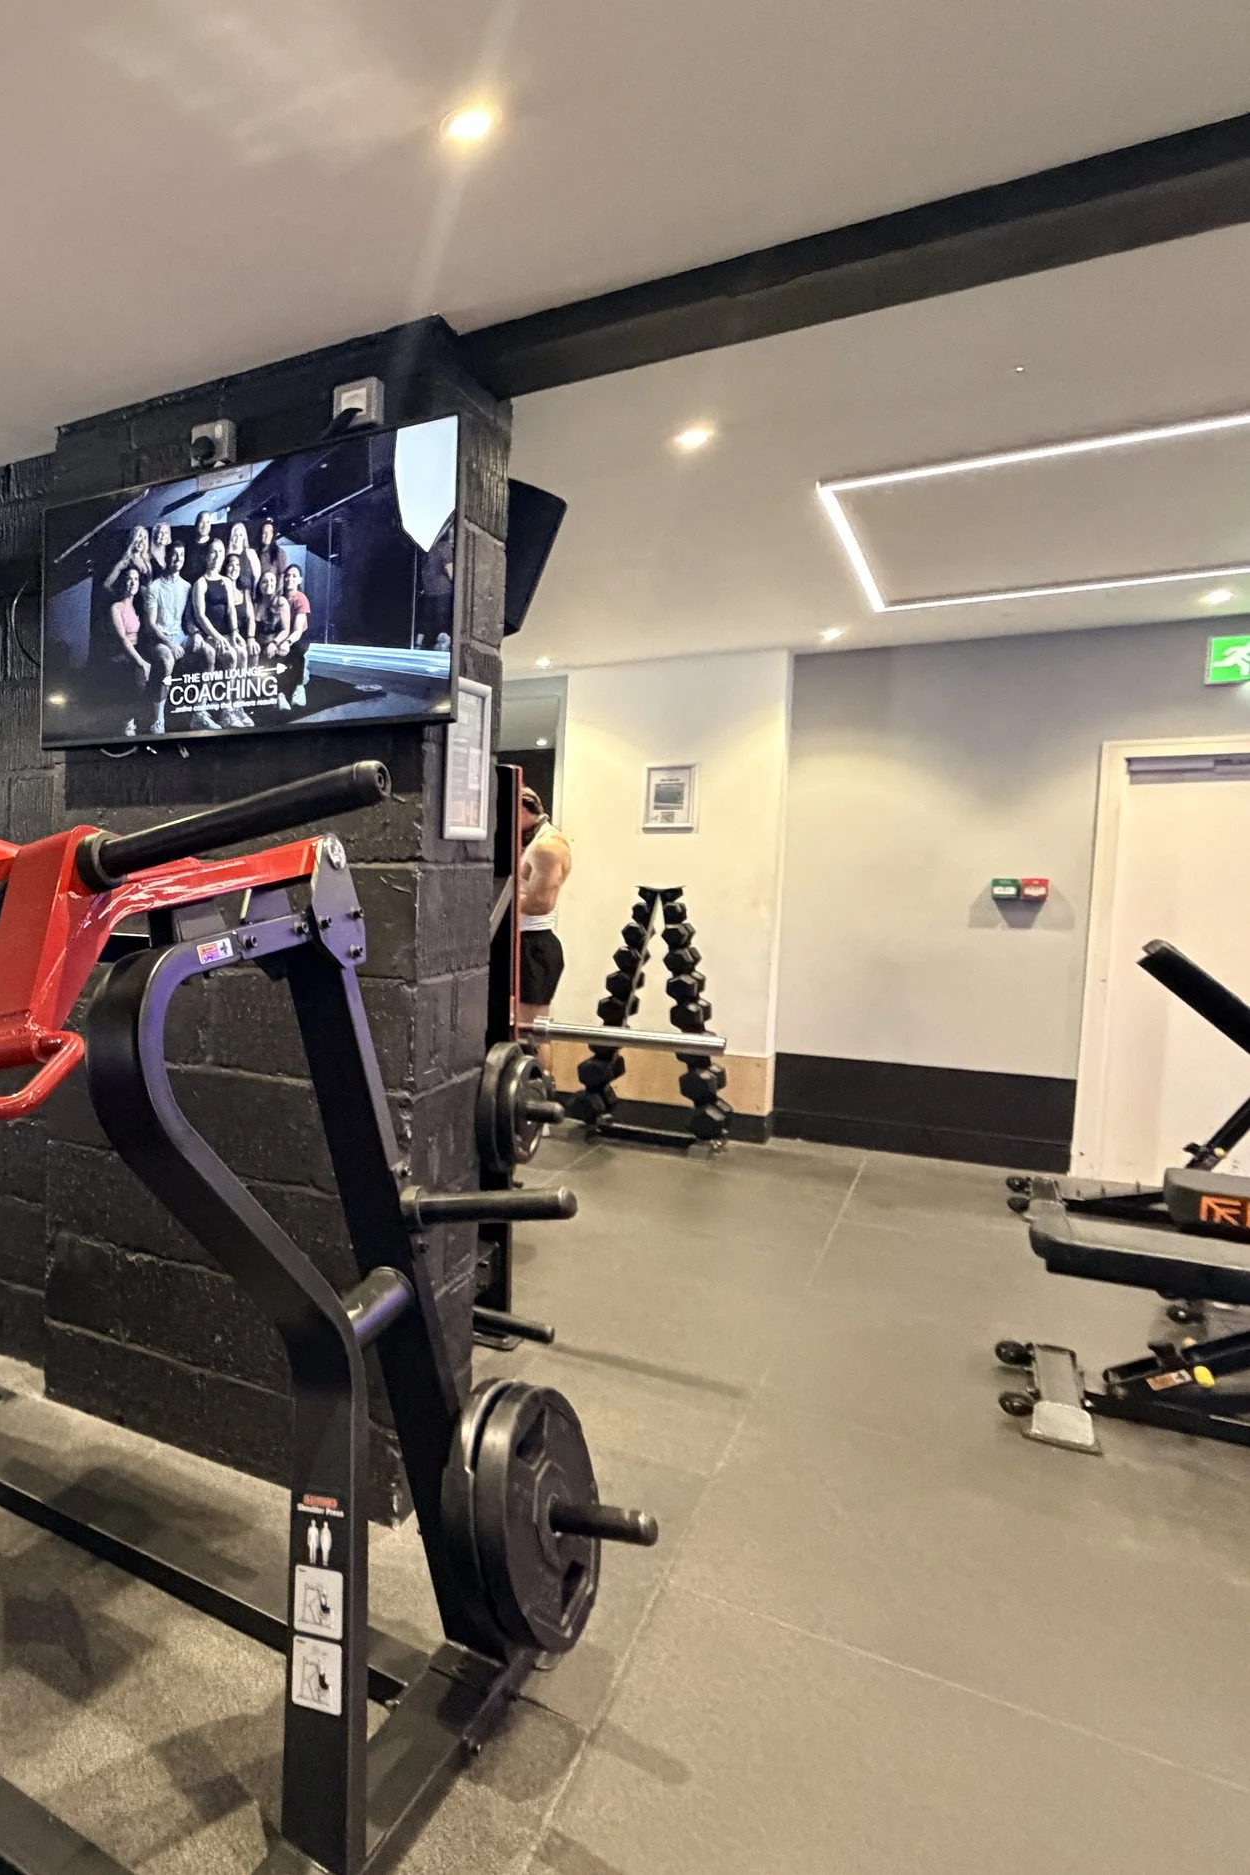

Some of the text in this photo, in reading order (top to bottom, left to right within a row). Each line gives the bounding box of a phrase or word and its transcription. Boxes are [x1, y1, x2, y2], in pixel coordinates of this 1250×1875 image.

[182, 665, 265, 684] THE GYM LOUNGE
[170, 677, 278, 705] COACHING
